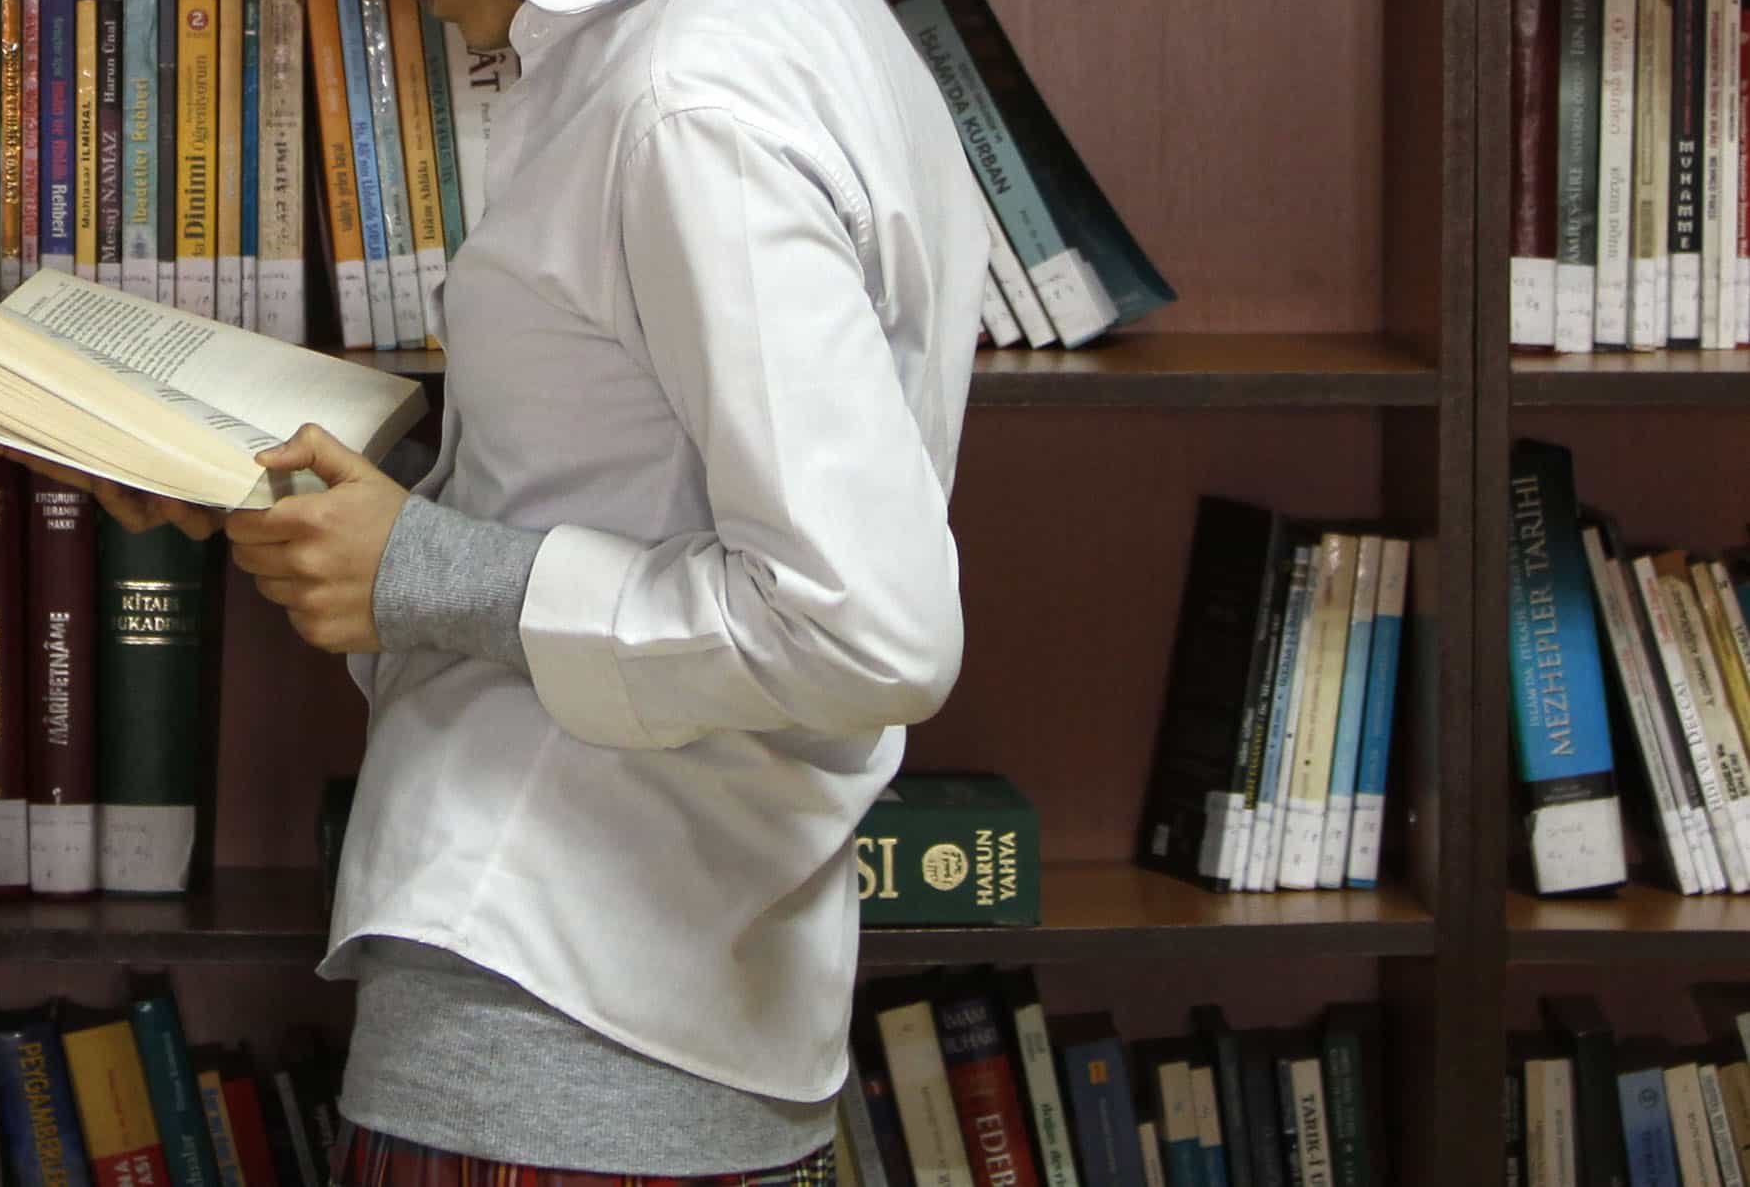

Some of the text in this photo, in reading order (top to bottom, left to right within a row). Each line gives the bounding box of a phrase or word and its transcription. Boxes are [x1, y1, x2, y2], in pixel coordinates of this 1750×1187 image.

[191, 11, 204, 27] 2
[100, 19, 120, 263] Mesaj NAMAZ Harun Ünal
[131, 77, 148, 143] Rehberi
[184, 55, 211, 241] Dinimi Öğreniyorum
[80, 100, 92, 230] Muhtasar İLMİHAL
[962, 117, 1011, 196] KURBAN
[51, 183, 68, 238] Rehberi
[47, 518, 76, 531] HAKKI
[1510, 473, 1578, 758] MEZHEPLER TARİHİ
[43, 611, 71, 746] MÂRİFETNÂME
[857, 836, 899, 901] SI
[975, 828, 995, 907] HARUN
[998, 830, 1018, 902] YAHYA
